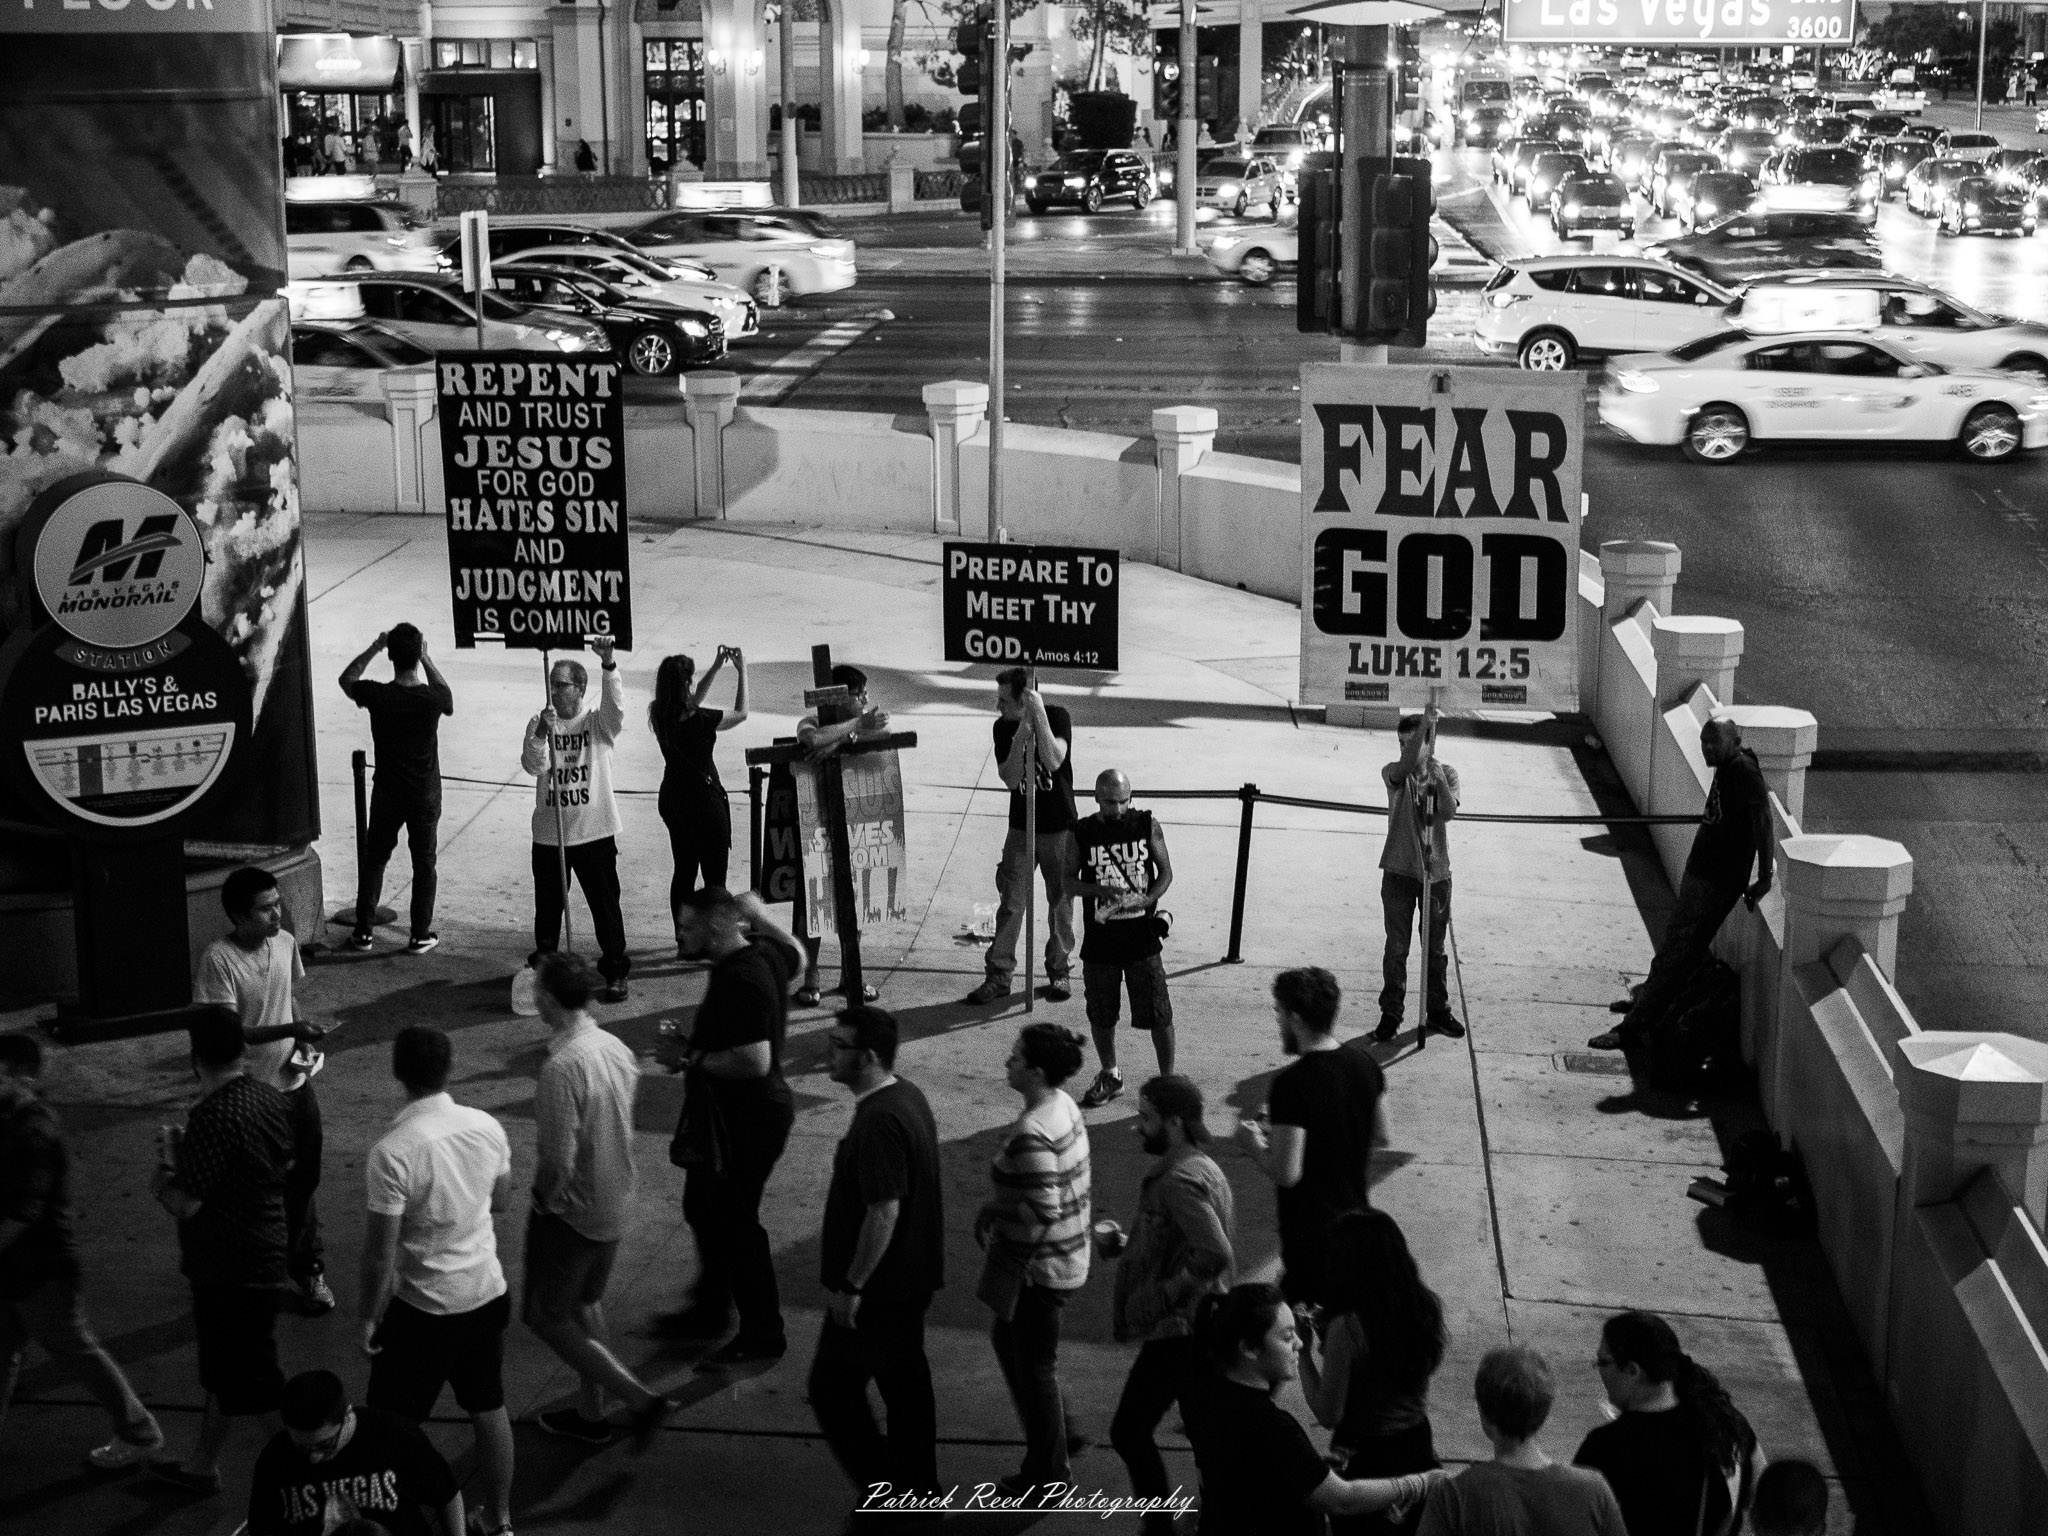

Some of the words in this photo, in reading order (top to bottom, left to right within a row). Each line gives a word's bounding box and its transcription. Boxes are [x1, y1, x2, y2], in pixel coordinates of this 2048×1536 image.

[1541, 0, 1618, 25] Las
[1640, 0, 1771, 38] Vegas
[1787, 15, 1842, 38] 3600
[440, 363, 617, 397] REPENT
[459, 402, 511, 427] AND
[520, 402, 606, 428] TRUST
[454, 435, 612, 469] JESUS
[1312, 403, 1570, 523] FEAR
[477, 470, 528, 496] FOR
[538, 470, 594, 496] GOD
[450, 498, 554, 533] HATES
[565, 500, 619, 533] SIN
[514, 537, 565, 564] AND
[62, 590, 100, 600] LAS
[114, 580, 180, 595] VEGAS
[456, 568, 622, 602] JUDGMENT
[1313, 527, 1567, 641] GOD
[58, 590, 176, 614] MONORAIL
[477, 607, 499, 631] IS
[510, 608, 610, 634] COMING
[74, 640, 172, 669] STATION
[1036, 648, 1070, 662] Amos
[1073, 651, 1099, 664] 4:12
[1348, 642, 1441, 679] LUKE
[1456, 647, 1530, 680] 12:5
[72, 677, 157, 701] BALLY'S
[163, 675, 179, 693] &
[35, 703, 98, 724] PARIS
[103, 699, 143, 718] LAS
[148, 692, 217, 714] VEGAS
[1087, 839, 1149, 867] JESUS
